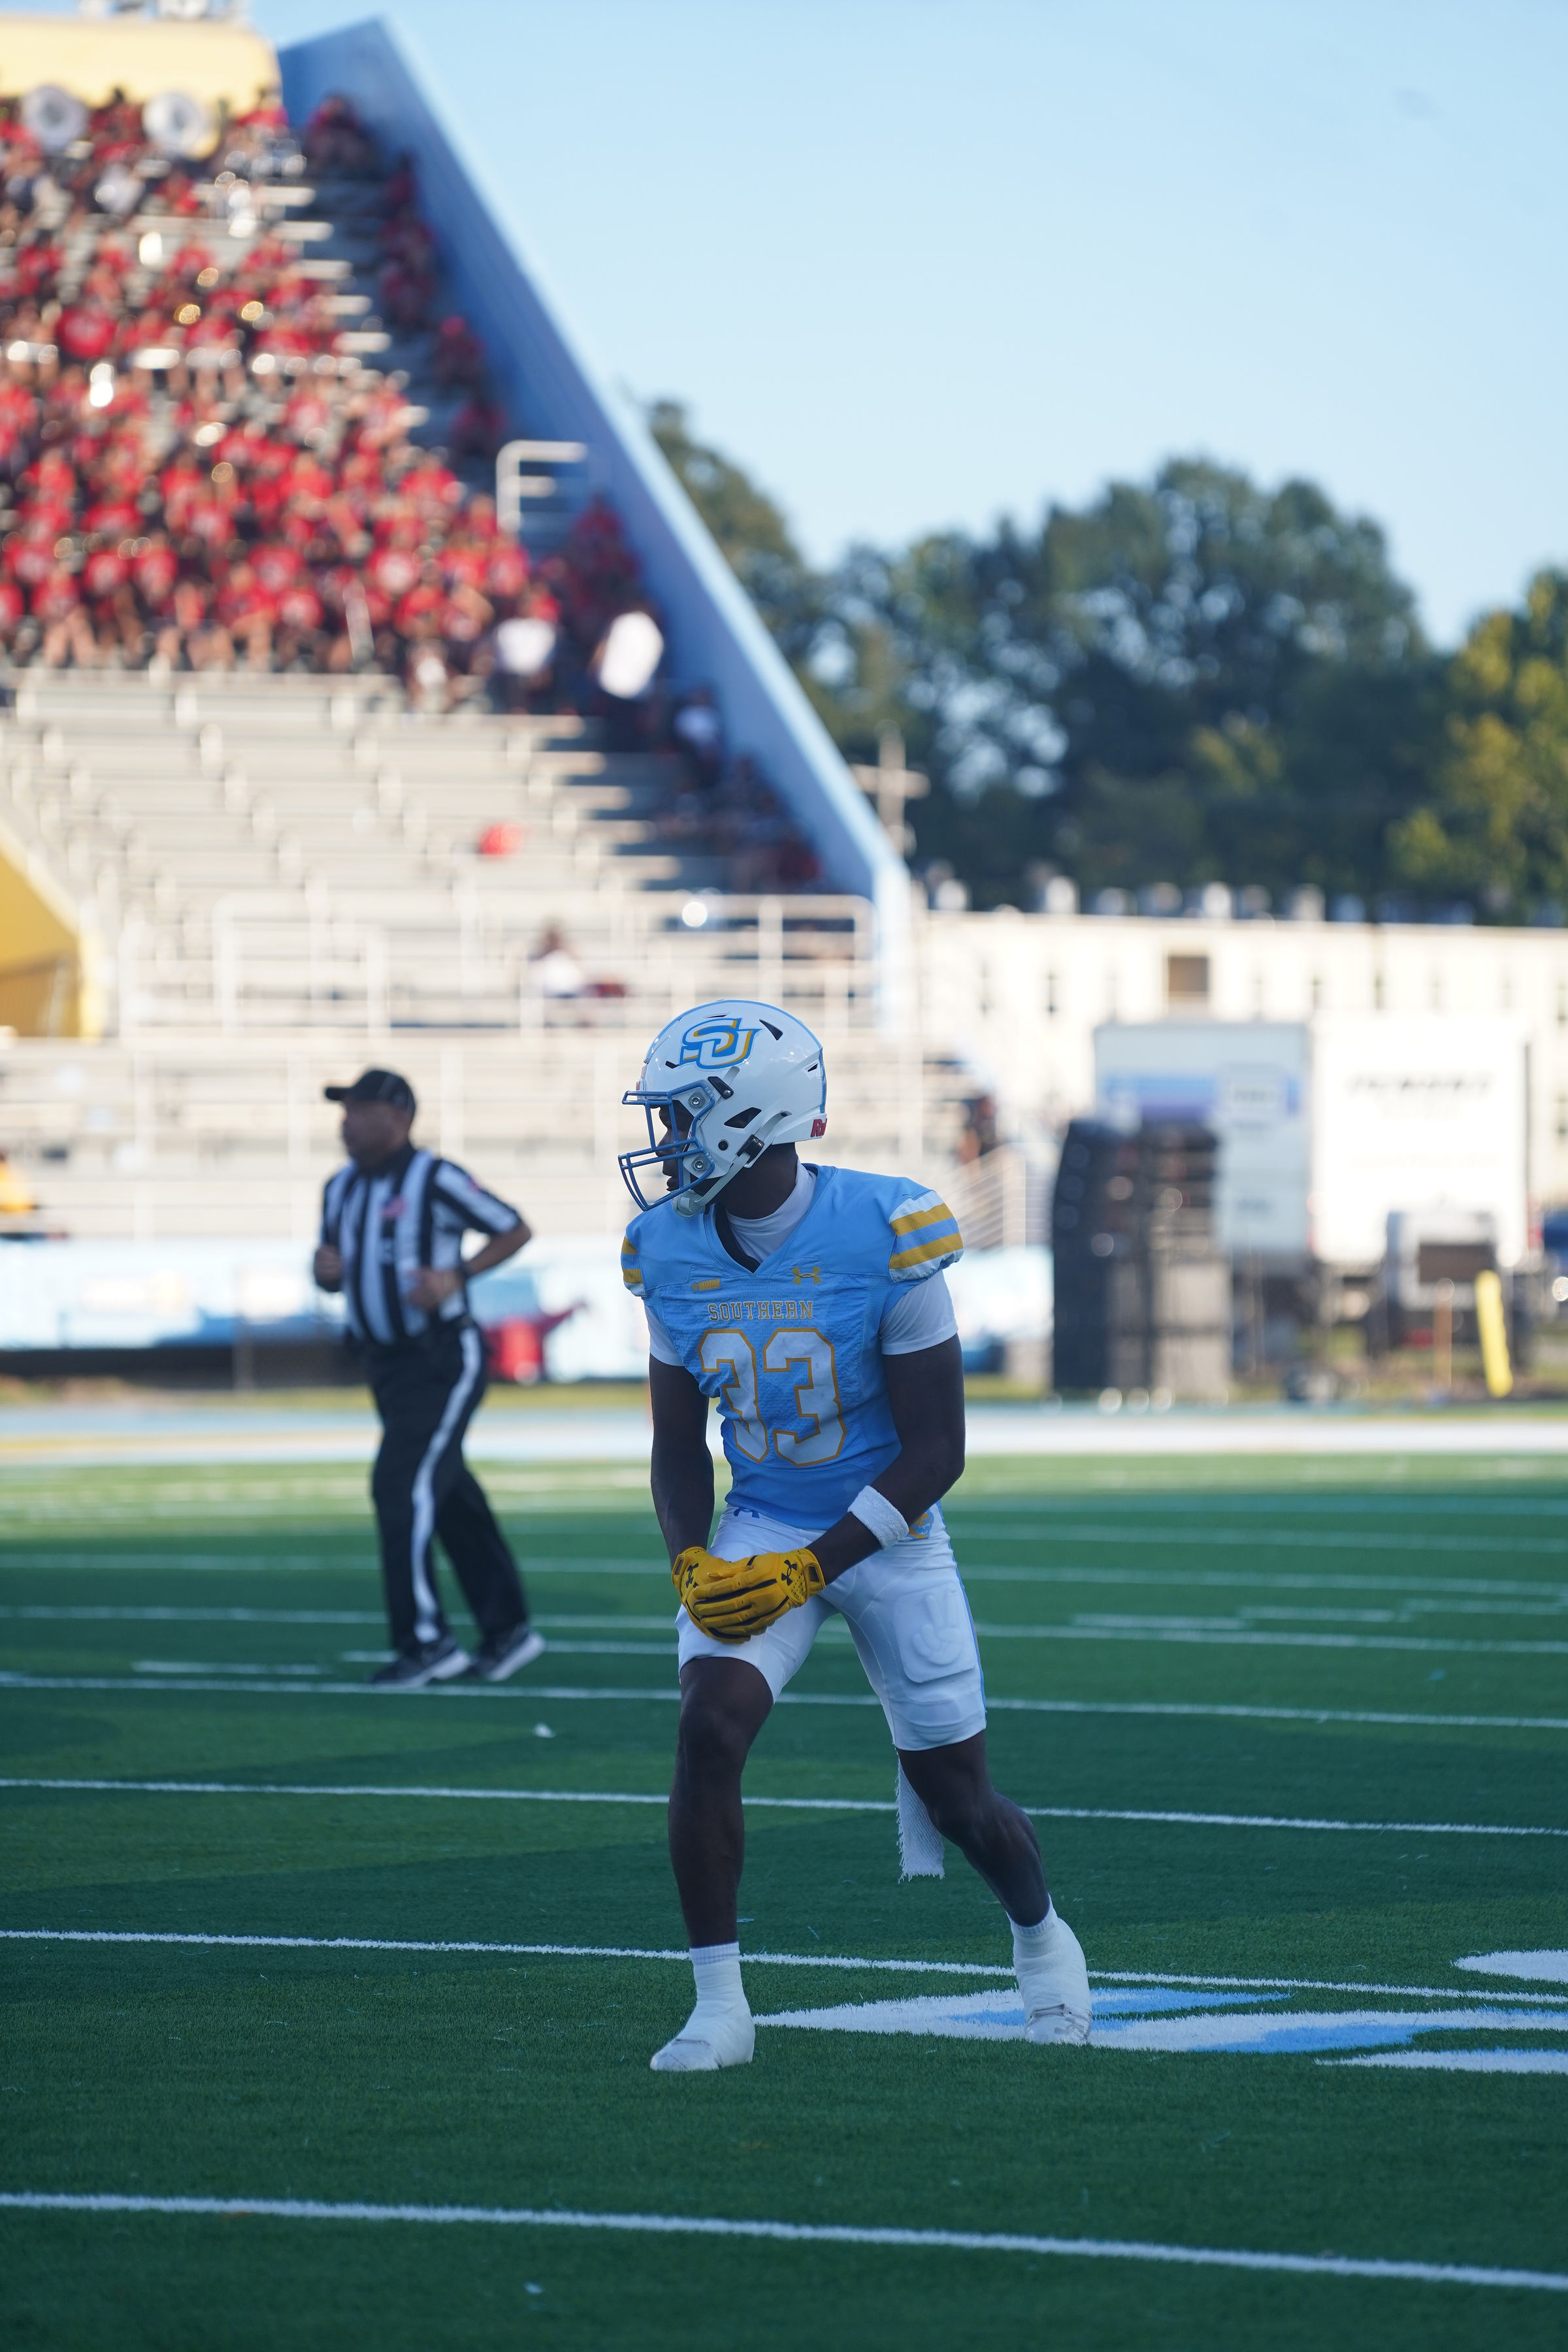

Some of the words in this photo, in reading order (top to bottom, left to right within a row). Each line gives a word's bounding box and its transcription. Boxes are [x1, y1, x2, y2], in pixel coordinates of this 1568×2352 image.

[679, 1017, 762, 1070] SU
[708, 1300, 814, 1322] SOUTHERN
[696, 1328, 848, 1467] 33
